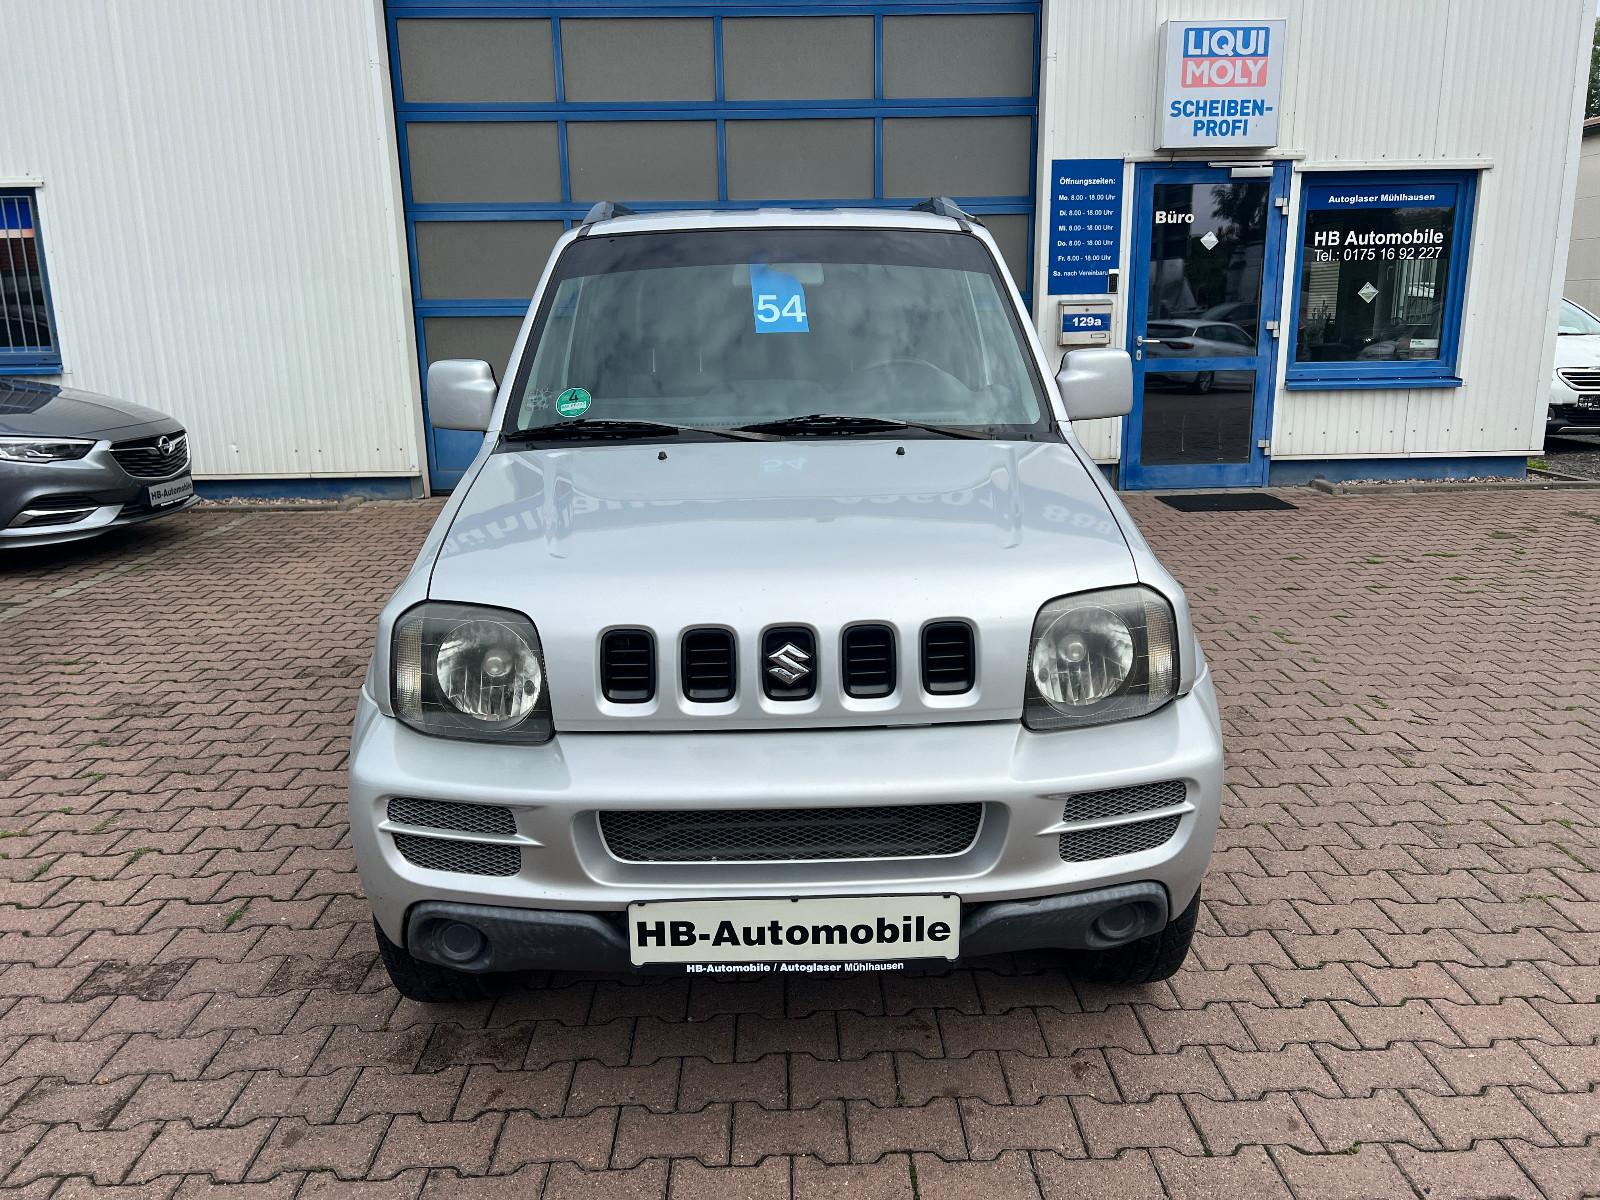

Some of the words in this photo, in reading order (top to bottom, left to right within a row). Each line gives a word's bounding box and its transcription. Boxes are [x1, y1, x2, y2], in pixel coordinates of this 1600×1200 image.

[1187, 29, 1266, 56] LIQUI
[1185, 59, 1266, 85] MOLY
[1169, 99, 1273, 118] SCHEIBEN-
[1193, 119, 1249, 137] PROFI
[1060, 176, 1116, 186] Öffnungszeiten:
[1105, 193, 1116, 201] Uhr
[1328, 194, 1378, 204] Autoglaser
[1380, 193, 1436, 202] Mühlhausen
[1103, 208, 1114, 216] Uhr
[1155, 210, 1195, 224] Büro
[1058, 224, 1068, 232] Mi.
[1314, 230, 1340, 247] HB
[1344, 228, 1444, 246] Automobile
[1314, 249, 1340, 262] Tel.:
[1343, 248, 1376, 261] 0175
[1380, 248, 1395, 260] 16
[1398, 247, 1415, 260] 92
[1418, 246, 1443, 259] 227
[757, 294, 807, 323] 54
[1072, 316, 1102, 327] 129a
[568, 389, 579, 402] 4
[636, 916, 951, 947] HB-Automobile
[686, 963, 771, 973] HB-Automobile
[780, 963, 842, 973] Autoglaser
[844, 962, 904, 972] Mühlhausen
